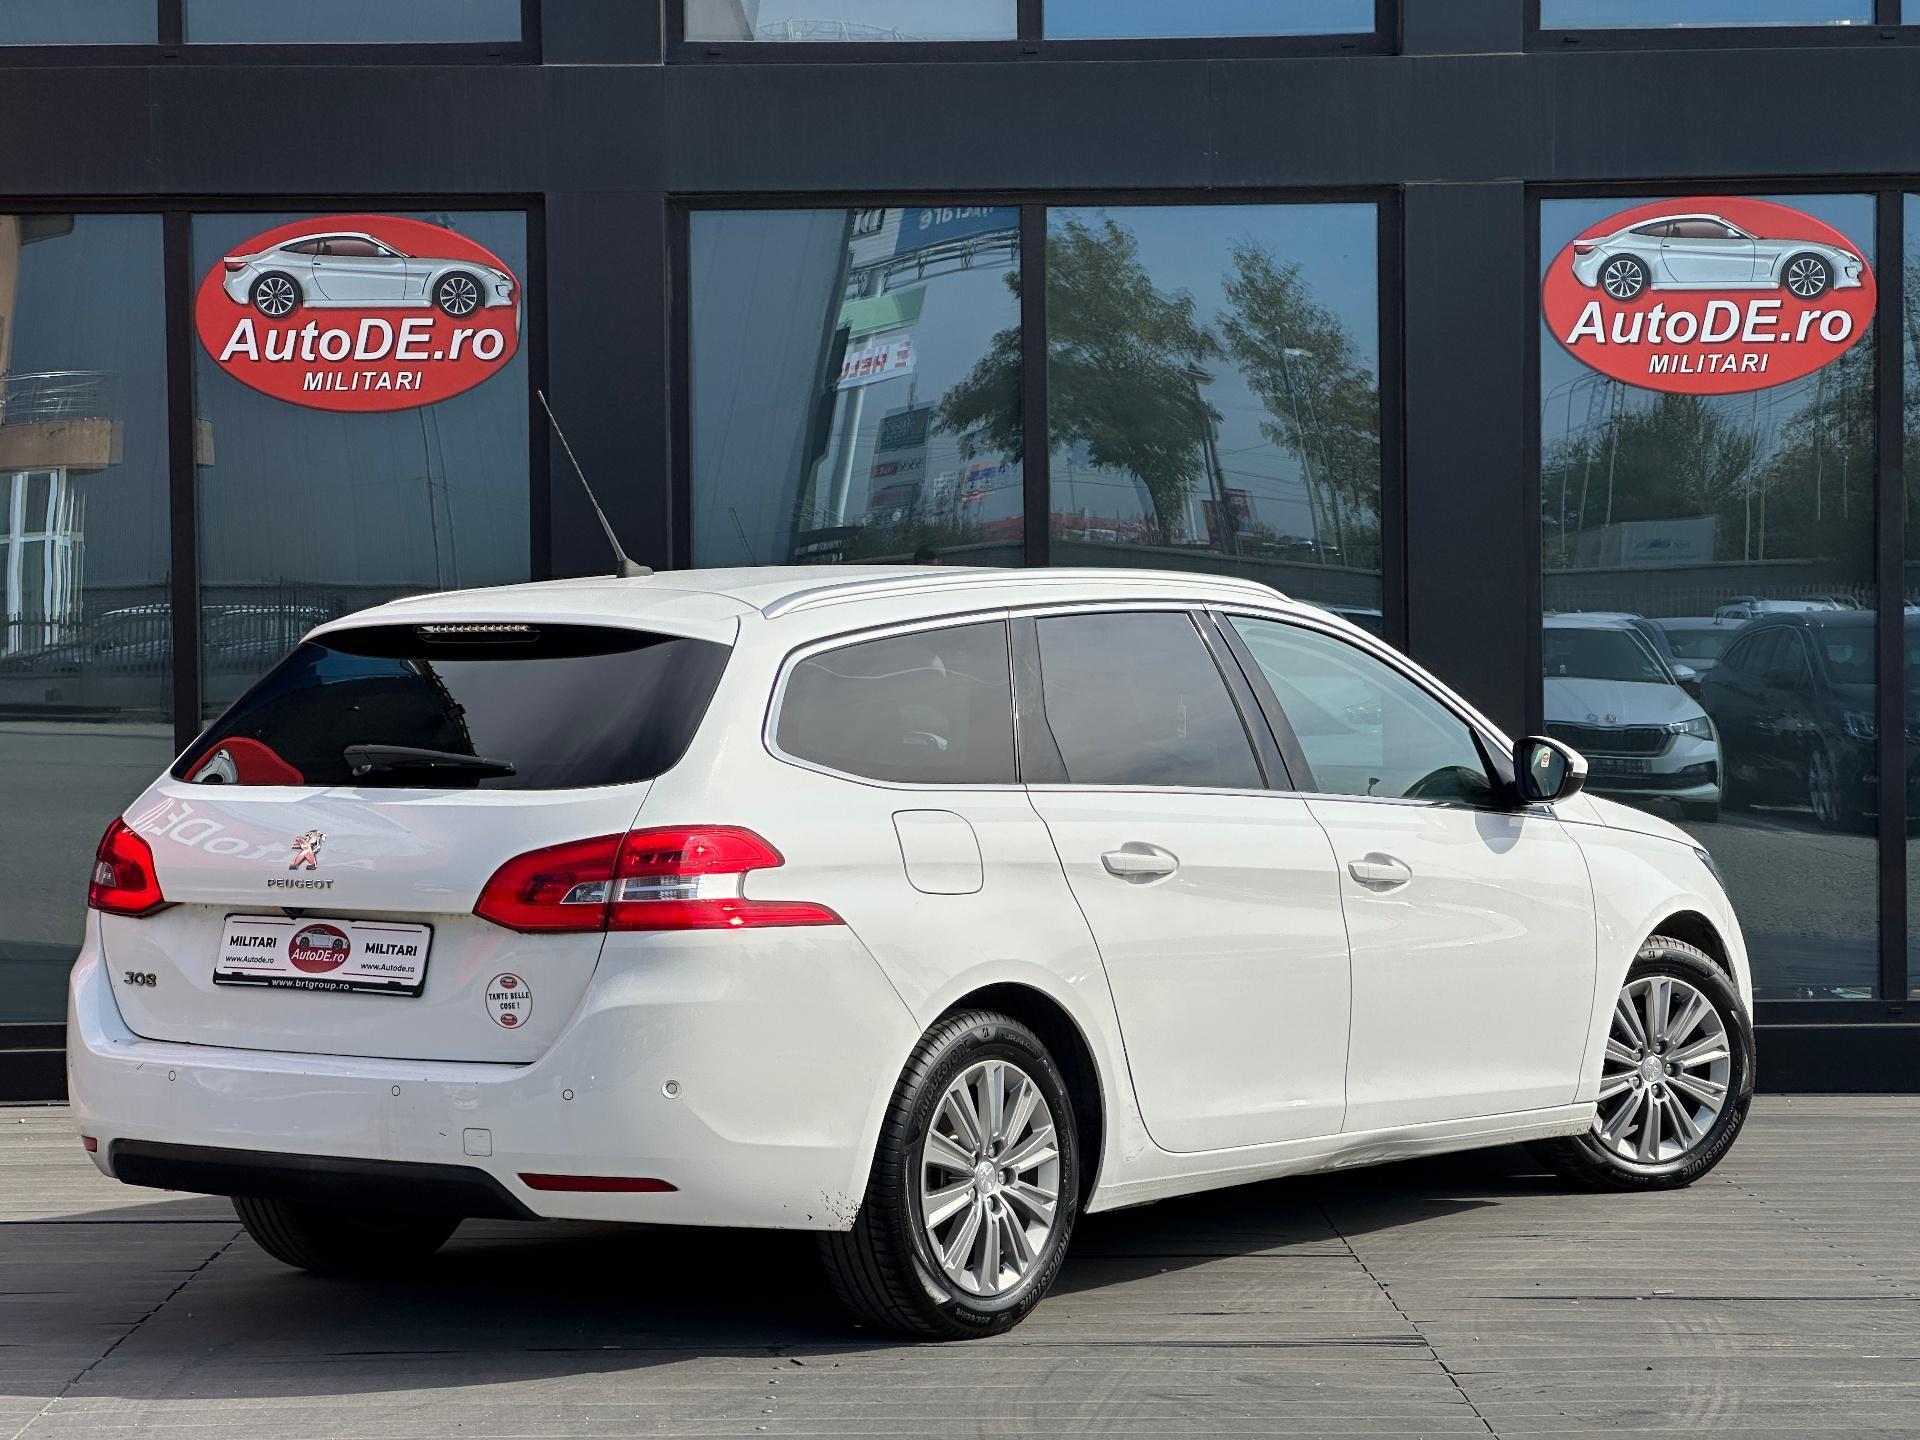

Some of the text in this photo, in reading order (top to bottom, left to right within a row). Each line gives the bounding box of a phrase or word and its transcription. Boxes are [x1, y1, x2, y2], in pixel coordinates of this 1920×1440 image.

[1566, 299, 1852, 344] AutoDE.ro
[219, 318, 505, 362] AutoDE.ro
[1648, 353, 1768, 374] MILITARI
[303, 371, 422, 391] MILITARI
[267, 878, 334, 890] PEUGEOT
[229, 935, 277, 948] MILITARI
[291, 948, 345, 963] AutoDE.ro
[364, 942, 418, 957] MILITARI
[225, 954, 275, 964] www.Autode.ro
[360, 962, 415, 973] www.Autode.ro
[123, 971, 157, 987] 308
[271, 978, 350, 991] www.brtgroup.ro
[1682, 1109, 1742, 1177] BRIDGESTONE
